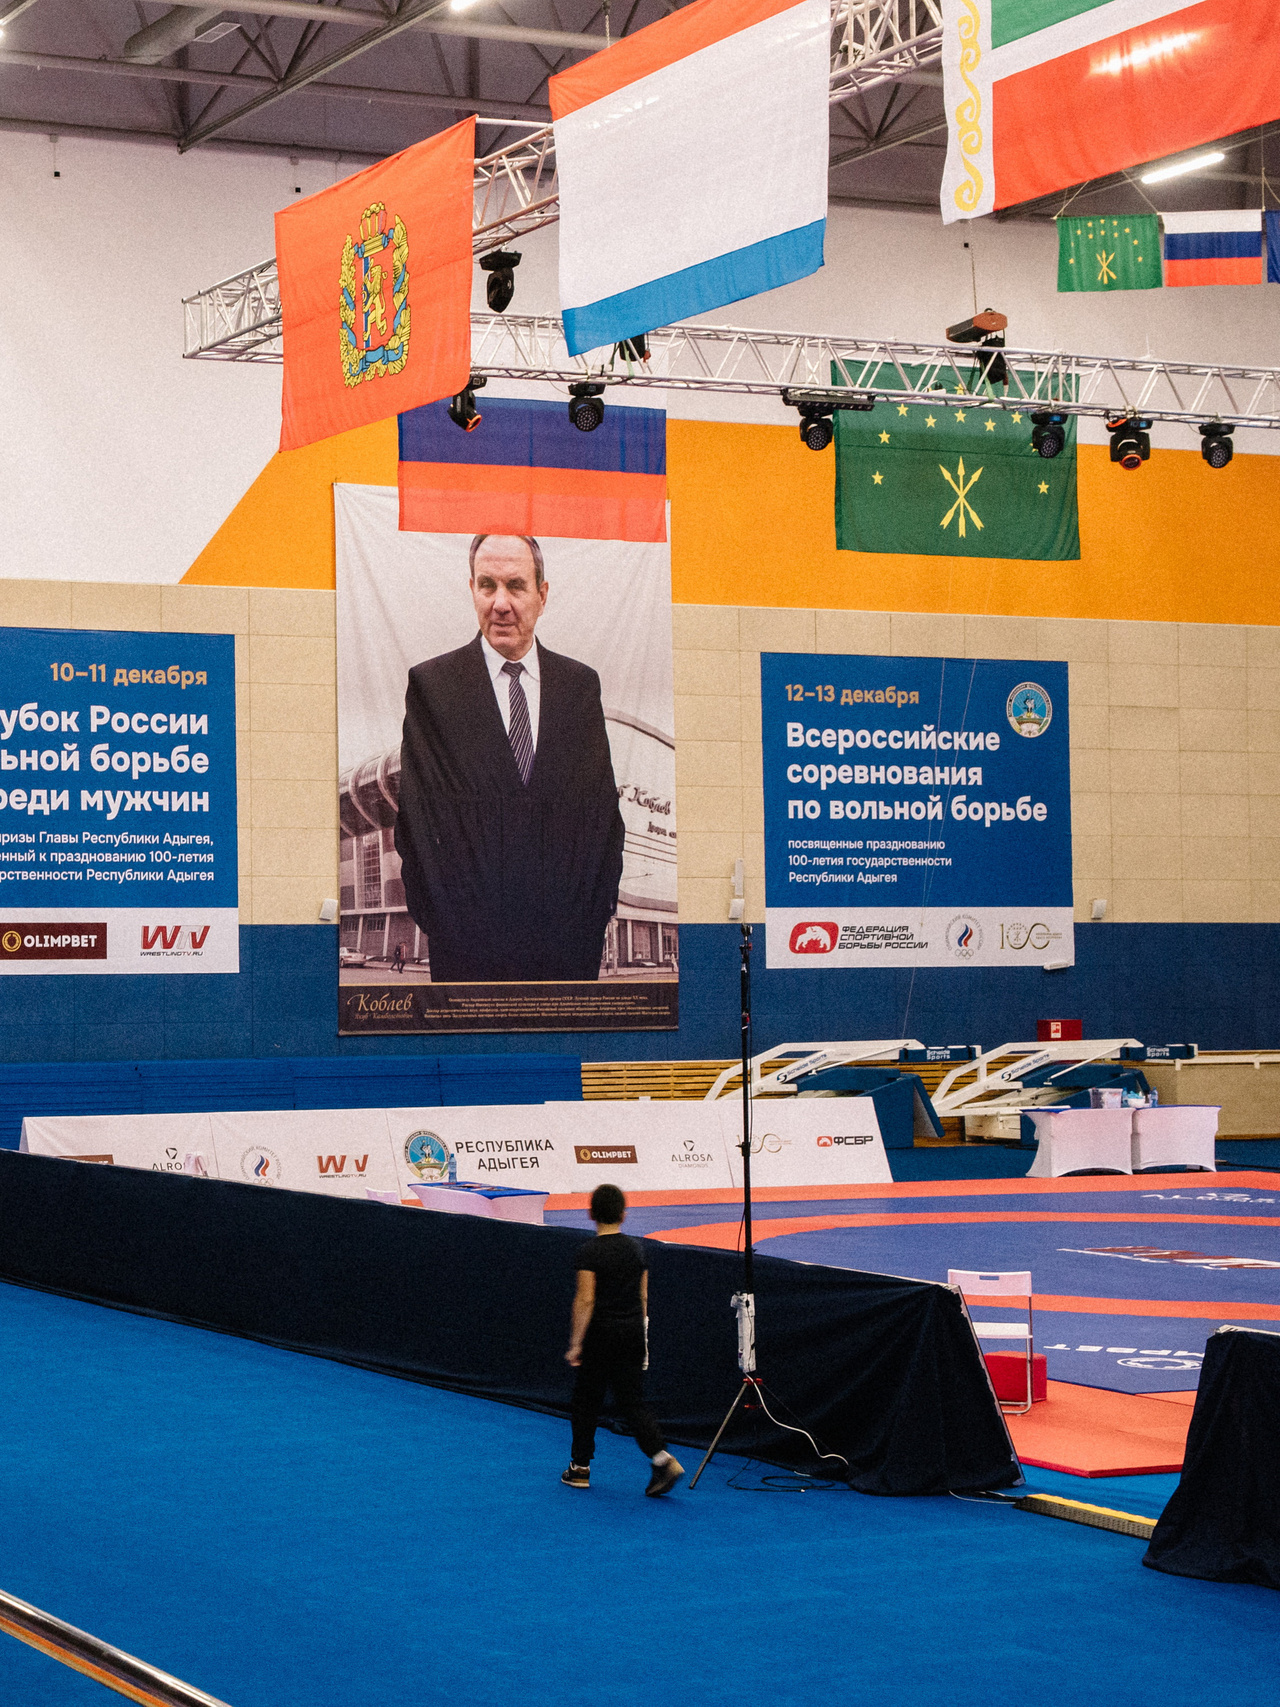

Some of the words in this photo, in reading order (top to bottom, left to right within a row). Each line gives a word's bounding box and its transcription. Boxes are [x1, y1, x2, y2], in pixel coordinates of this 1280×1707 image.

[114, 665, 207, 690] декабря
[841, 686, 919, 708] декабря
[90, 705, 208, 735] России
[786, 722, 1000, 755] Всероссийские
[90, 744, 209, 780] борьбе
[787, 763, 983, 790] соревнования
[80, 789, 210, 821] мужчин
[788, 799, 821, 819] по
[830, 795, 942, 820] вольной
[951, 796, 1047, 827] борьбе
[39, 831, 78, 845] Главы
[82, 832, 160, 848] Республики
[162, 832, 214, 847] Адыгея,
[788, 840, 864, 851] посвященные
[866, 839, 946, 852] празднованию
[39, 851, 47, 862] к
[50, 852, 146, 866] празднованию
[149, 851, 214, 863] 100-летия
[788, 855, 844, 866] 100-летия
[846, 856, 952, 868] государственности
[86, 868, 164, 884] Республики
[167, 869, 215, 883] Адыгея
[789, 871, 854, 885] Республики
[857, 872, 897, 884] Адыгея
[840, 932, 914, 942] СПОРТИВНОЙ
[842, 926, 909, 934] ФЕДЕРАЦИЯ
[23, 934, 98, 950] OLIMPBET
[838, 940, 882, 949] БОРЬБЫ
[884, 940, 928, 949] РОССИИ
[347, 993, 413, 1012] Коблев
[455, 1139, 554, 1153] РЕСПУБЛИКА
[834, 1136, 873, 1145] ФСБР
[591, 1151, 632, 1159] OLIMPBET
[671, 1153, 713, 1162] ALROSA
[153, 1162, 184, 1171] ALRO
[478, 1157, 539, 1171] АДЫГЕЯ
